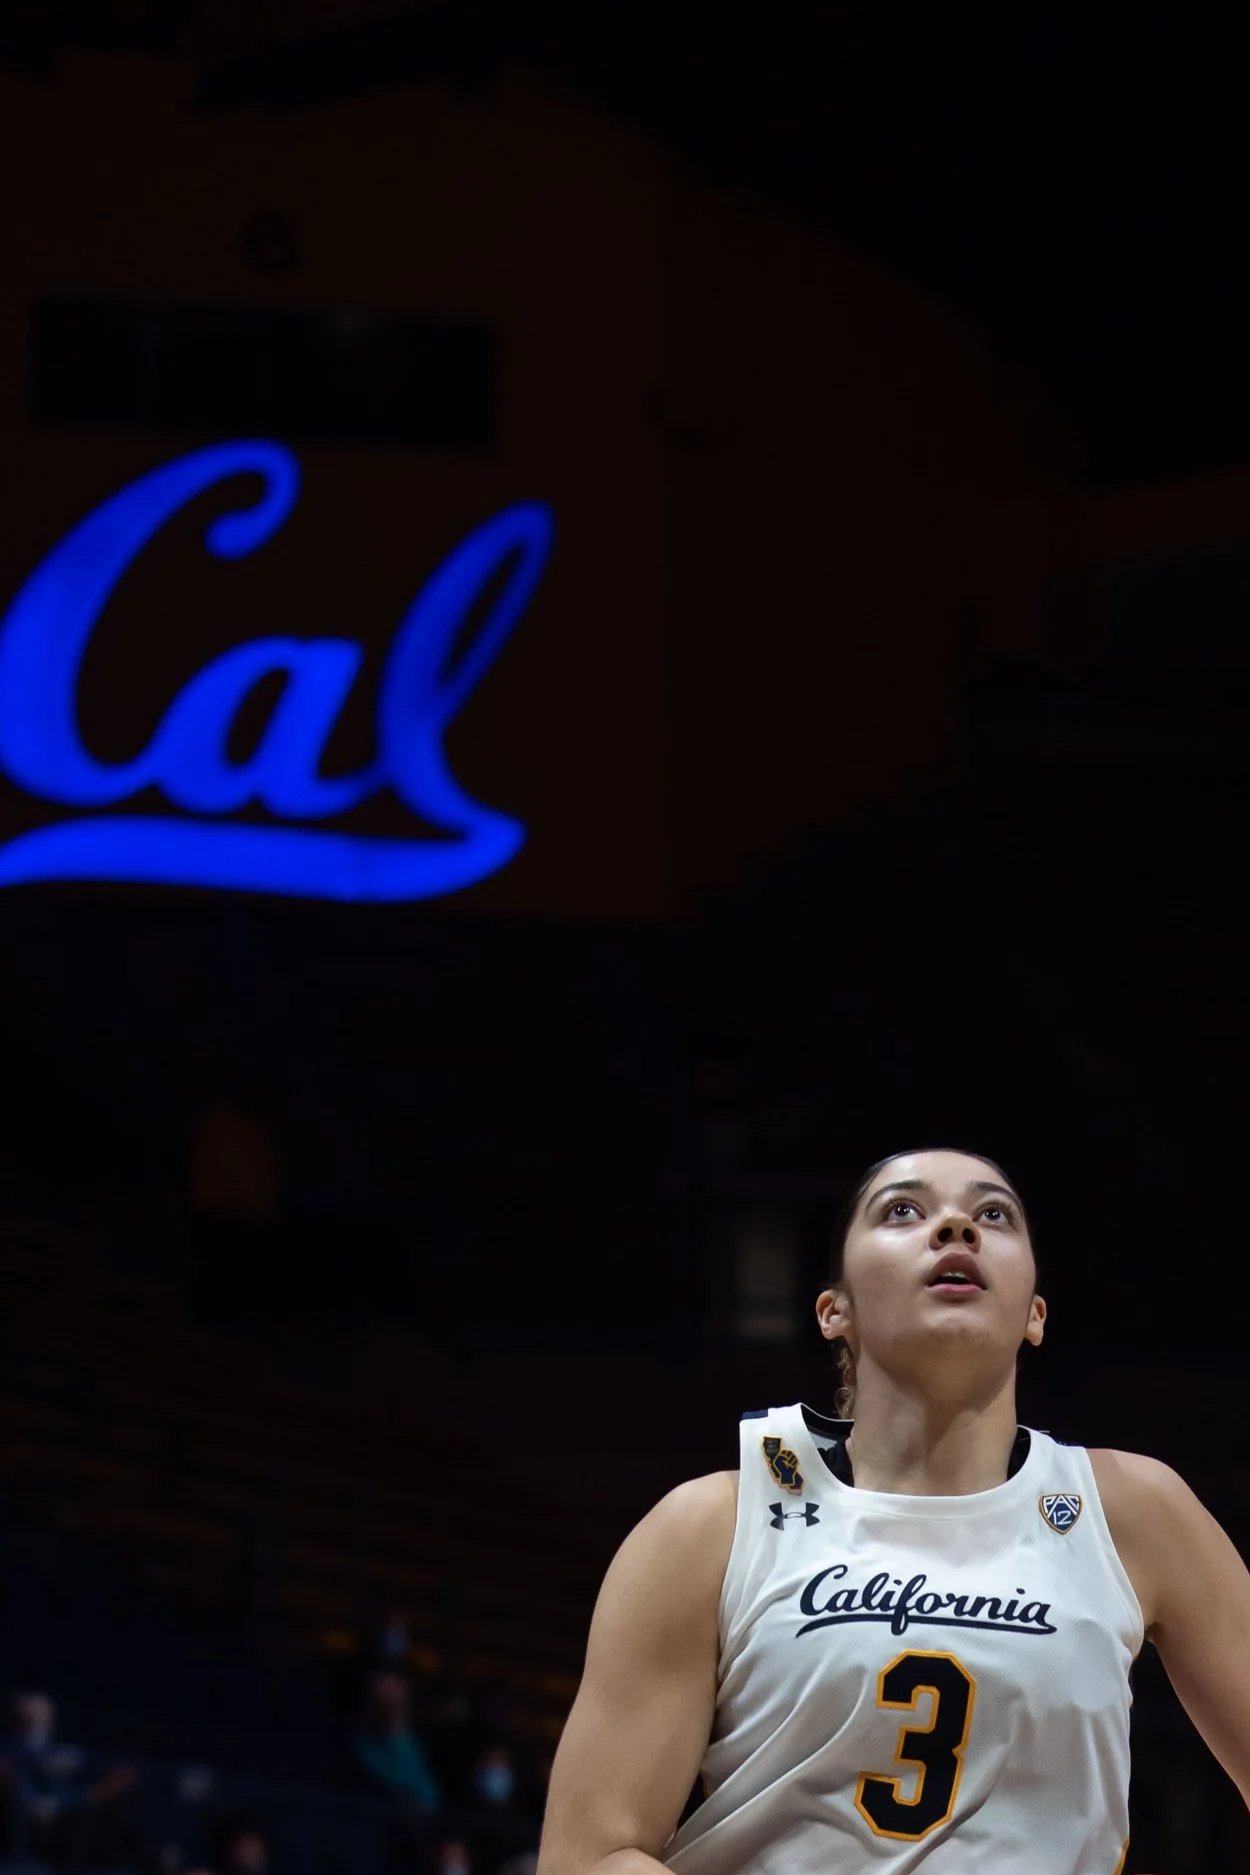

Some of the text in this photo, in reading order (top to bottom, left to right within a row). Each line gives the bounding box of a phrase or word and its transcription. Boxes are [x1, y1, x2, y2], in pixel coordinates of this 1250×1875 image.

[0, 438, 557, 902] Cal
[1043, 1495, 1080, 1518] PAC
[1053, 1510, 1073, 1525] 12
[796, 1564, 1057, 1638] California
[854, 1650, 976, 1842] 3
